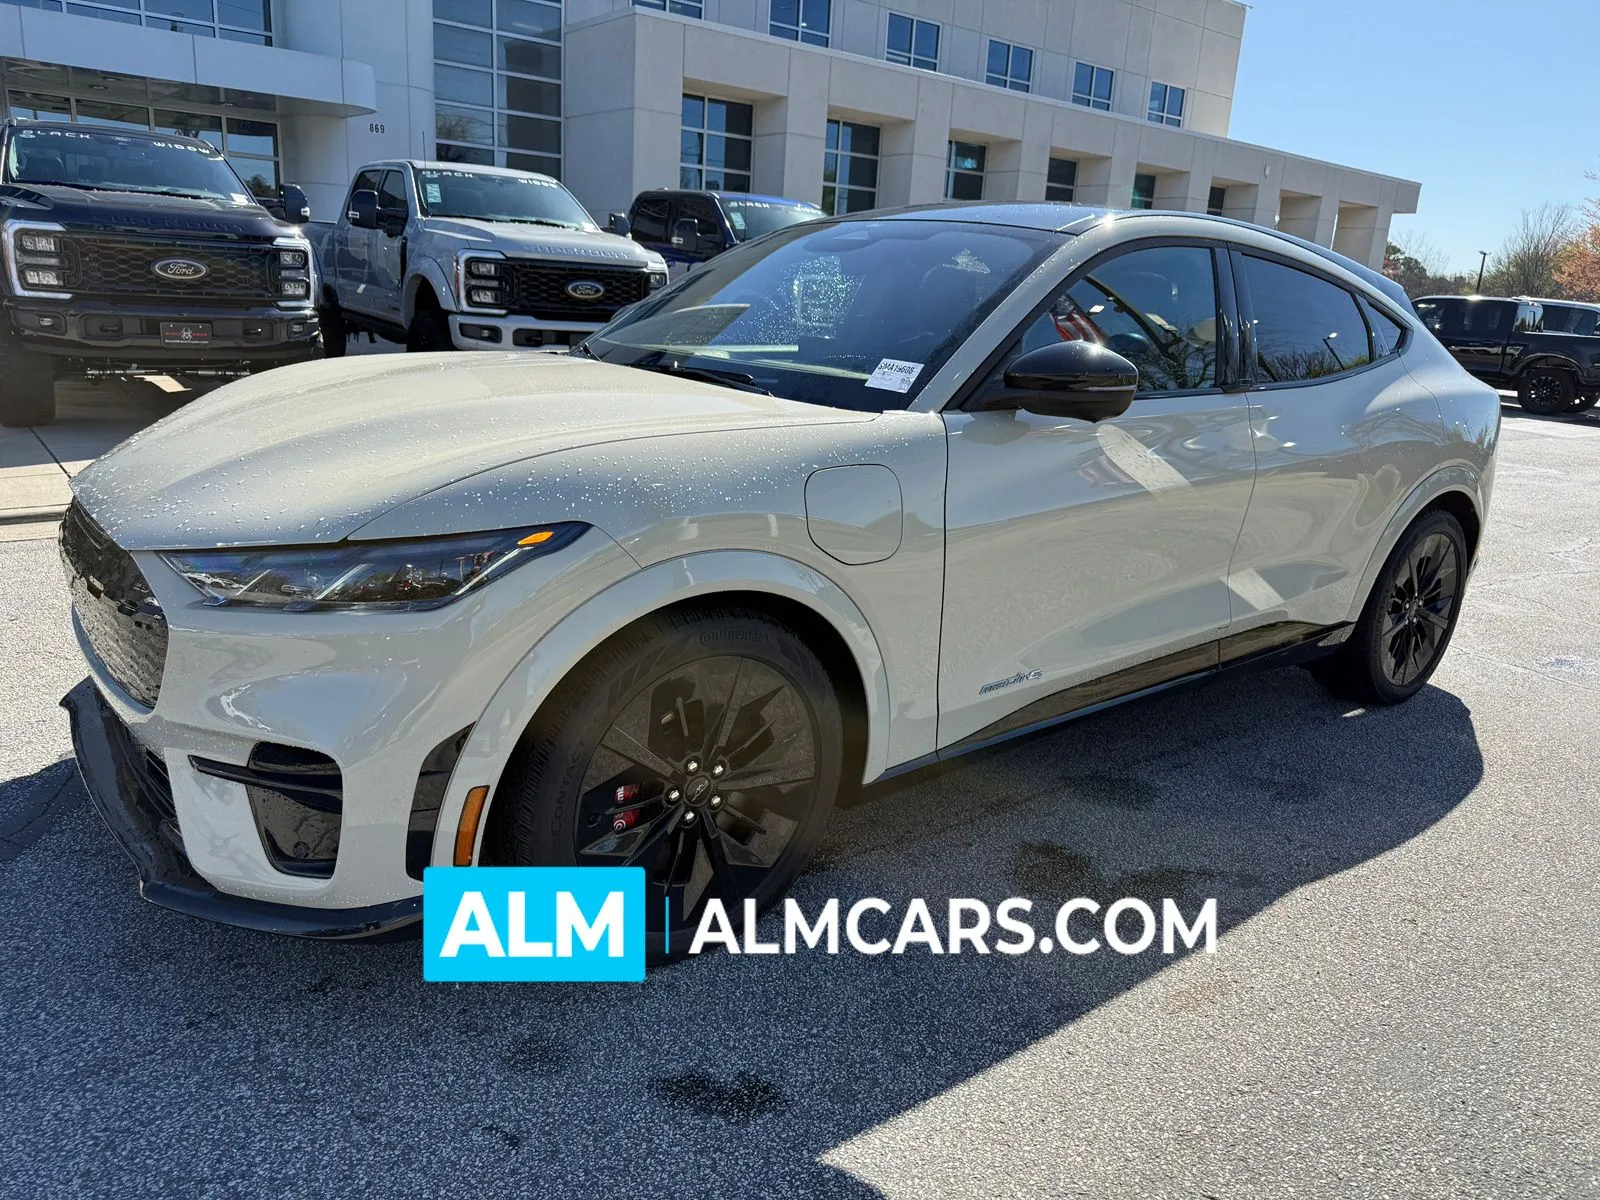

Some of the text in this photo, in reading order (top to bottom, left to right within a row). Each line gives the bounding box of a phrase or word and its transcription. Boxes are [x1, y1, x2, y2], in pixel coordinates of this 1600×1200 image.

[369, 123, 385, 134] 869
[153, 141, 210, 154] WIDOW
[167, 263, 195, 275] Ford
